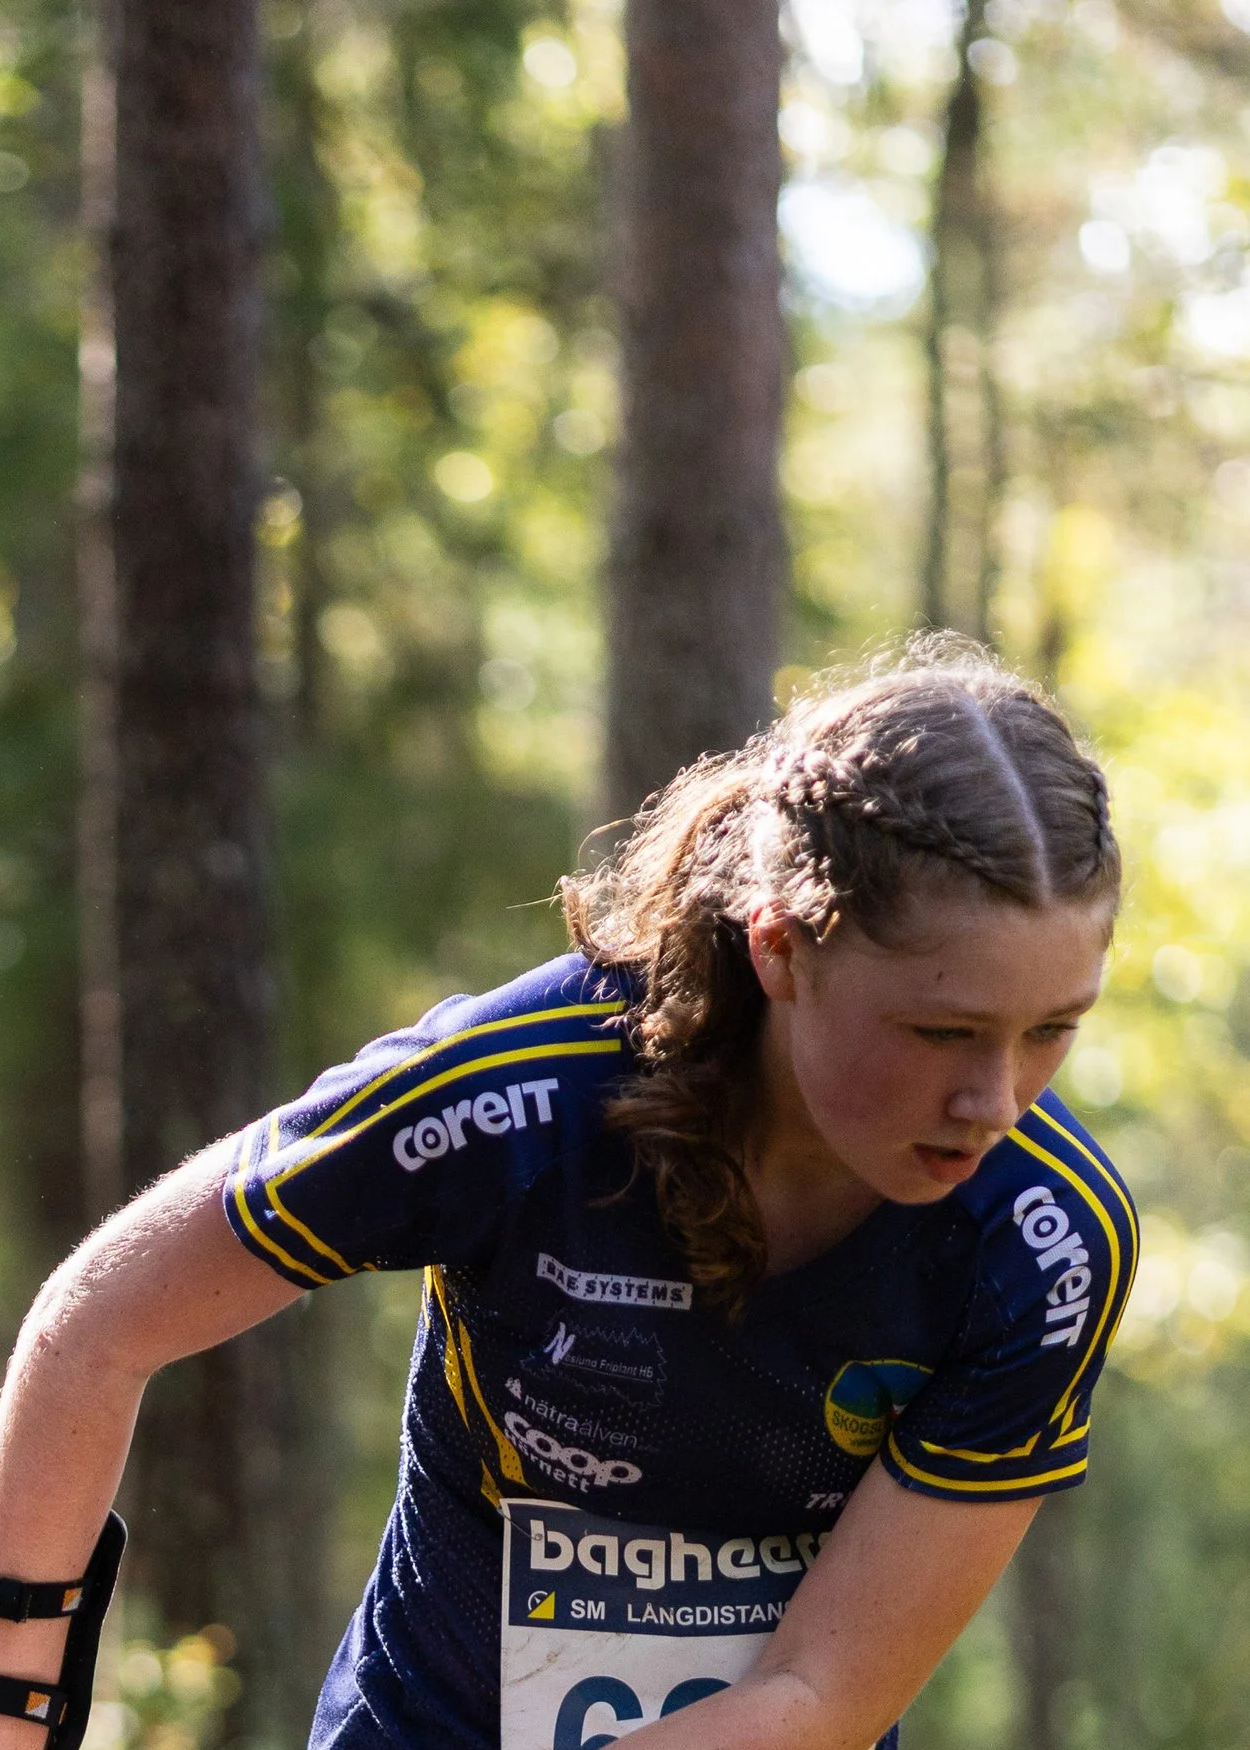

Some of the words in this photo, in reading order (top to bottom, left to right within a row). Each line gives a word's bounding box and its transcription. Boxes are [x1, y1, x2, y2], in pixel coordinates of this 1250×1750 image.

[547, 1261, 579, 1290] BAE
[585, 1280, 685, 1302] SYSTEMS
[570, 1598, 606, 1620] SM
